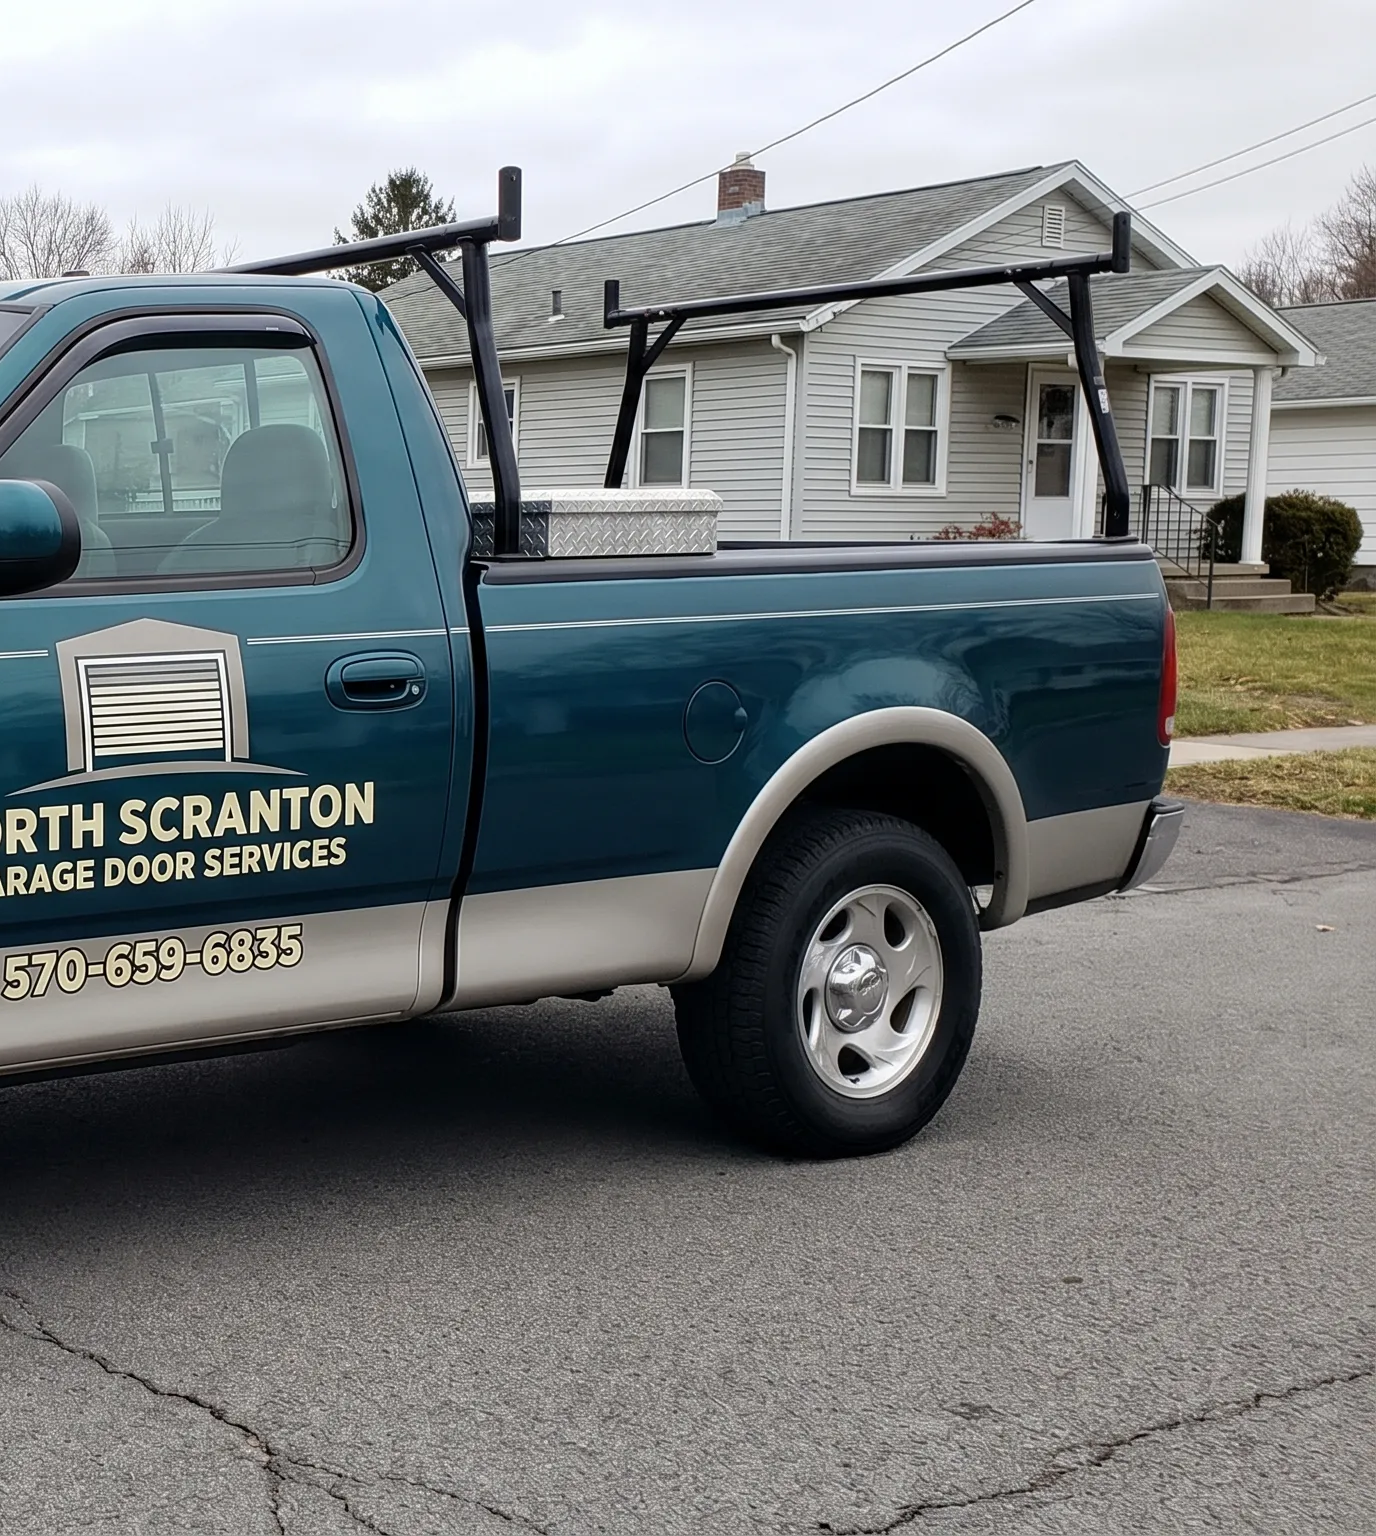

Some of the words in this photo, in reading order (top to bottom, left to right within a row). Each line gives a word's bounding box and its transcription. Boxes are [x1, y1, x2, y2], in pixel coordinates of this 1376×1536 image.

[119, 781, 375, 845] SCRANTON
[104, 851, 195, 887] DOOR
[203, 836, 347, 878] SERVICES
[1, 923, 304, 1001] 570-659-6835
